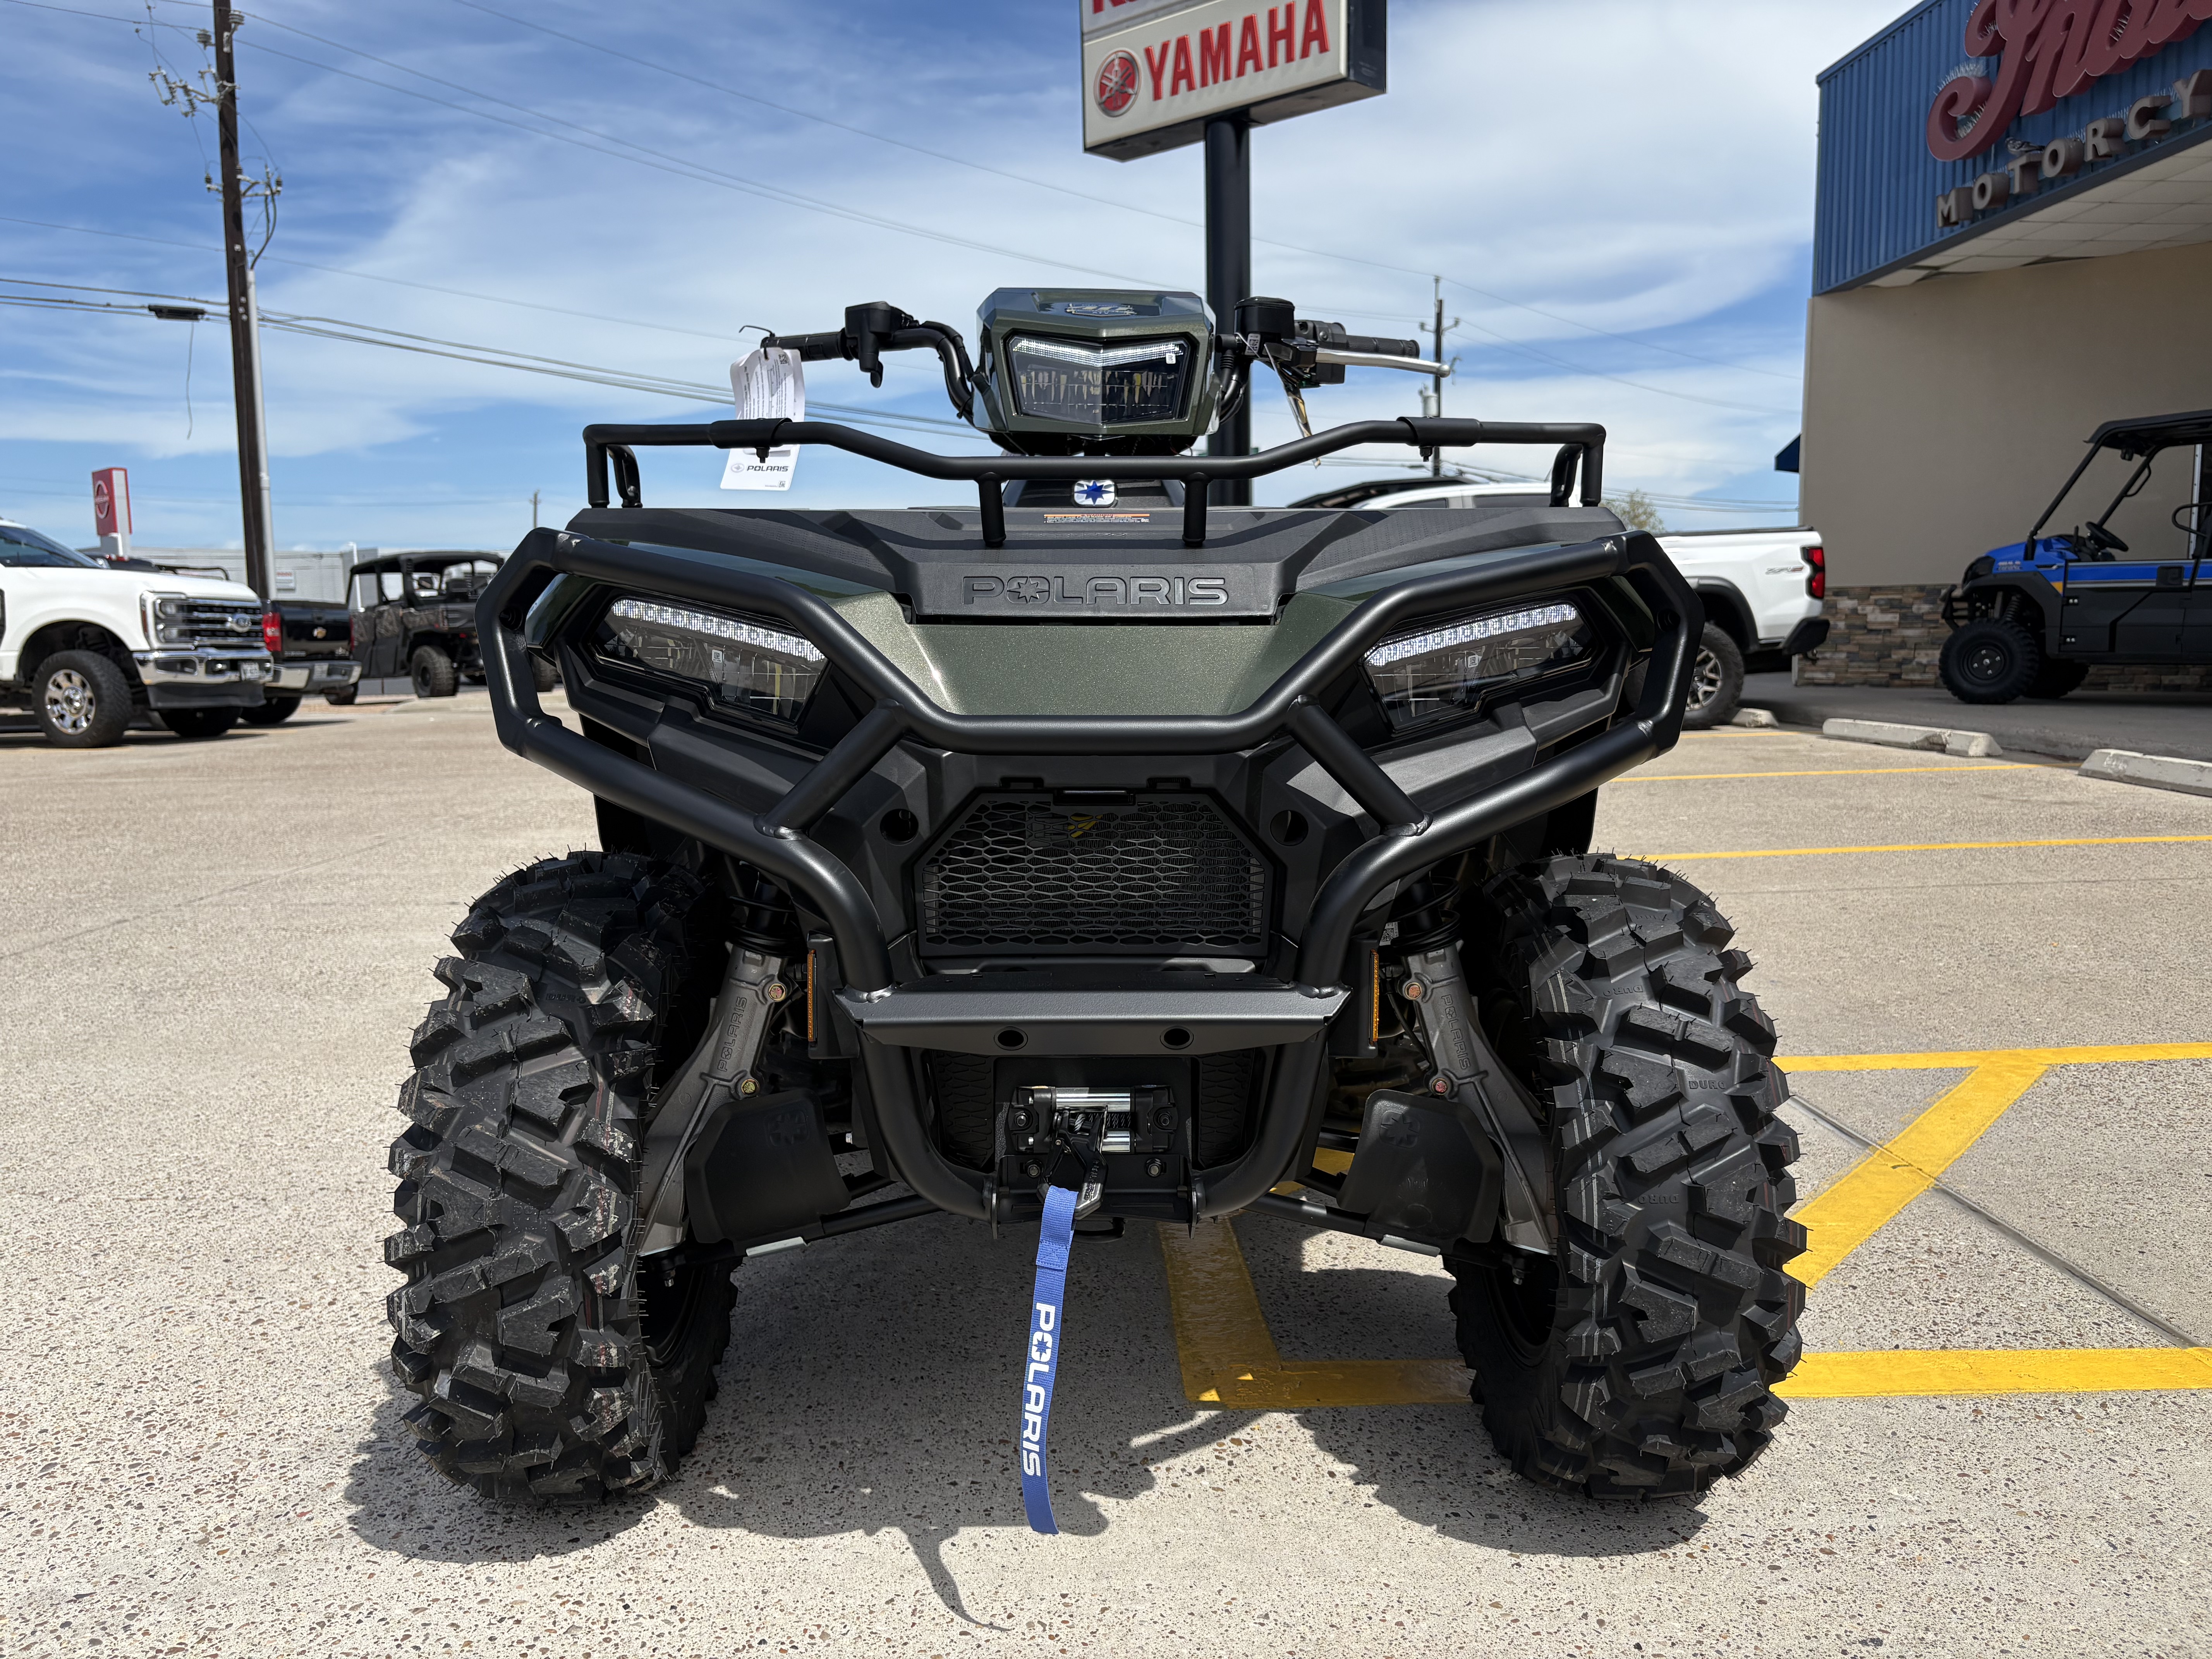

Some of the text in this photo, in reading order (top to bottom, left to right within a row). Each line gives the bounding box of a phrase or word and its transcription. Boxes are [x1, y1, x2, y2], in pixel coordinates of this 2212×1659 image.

[1144, 0, 1331, 101] YAMAHA
[962, 576, 1229, 605] POLARIS
[717, 996, 747, 1072] POLARIS
[1441, 994, 1471, 1070] POLARIS
[1689, 1080, 1727, 1089] DURO
[1022, 1302, 1056, 1477] POLARIS
